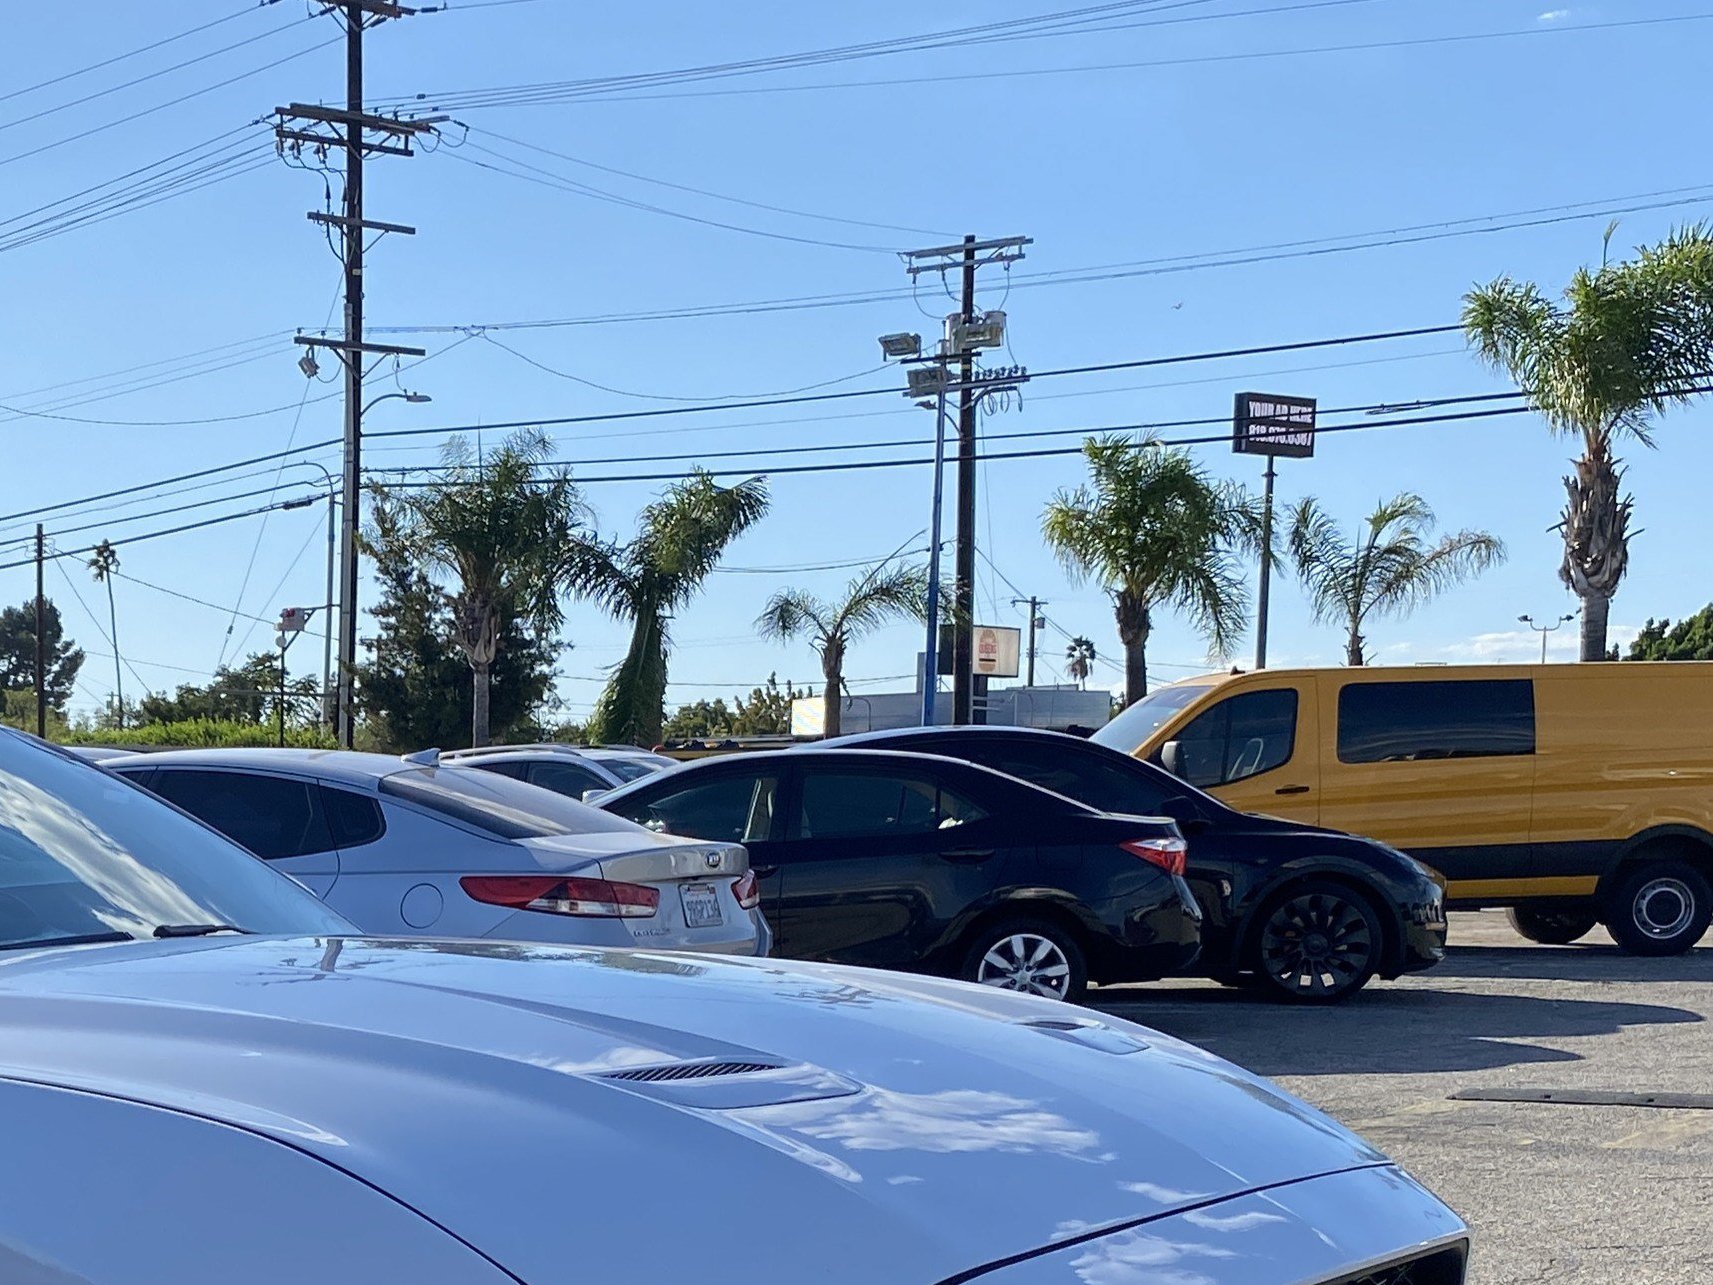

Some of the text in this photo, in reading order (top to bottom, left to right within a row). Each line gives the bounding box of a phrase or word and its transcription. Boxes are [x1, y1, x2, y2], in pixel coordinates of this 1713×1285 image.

[1249, 401, 1312, 423] YOUR AD HERE
